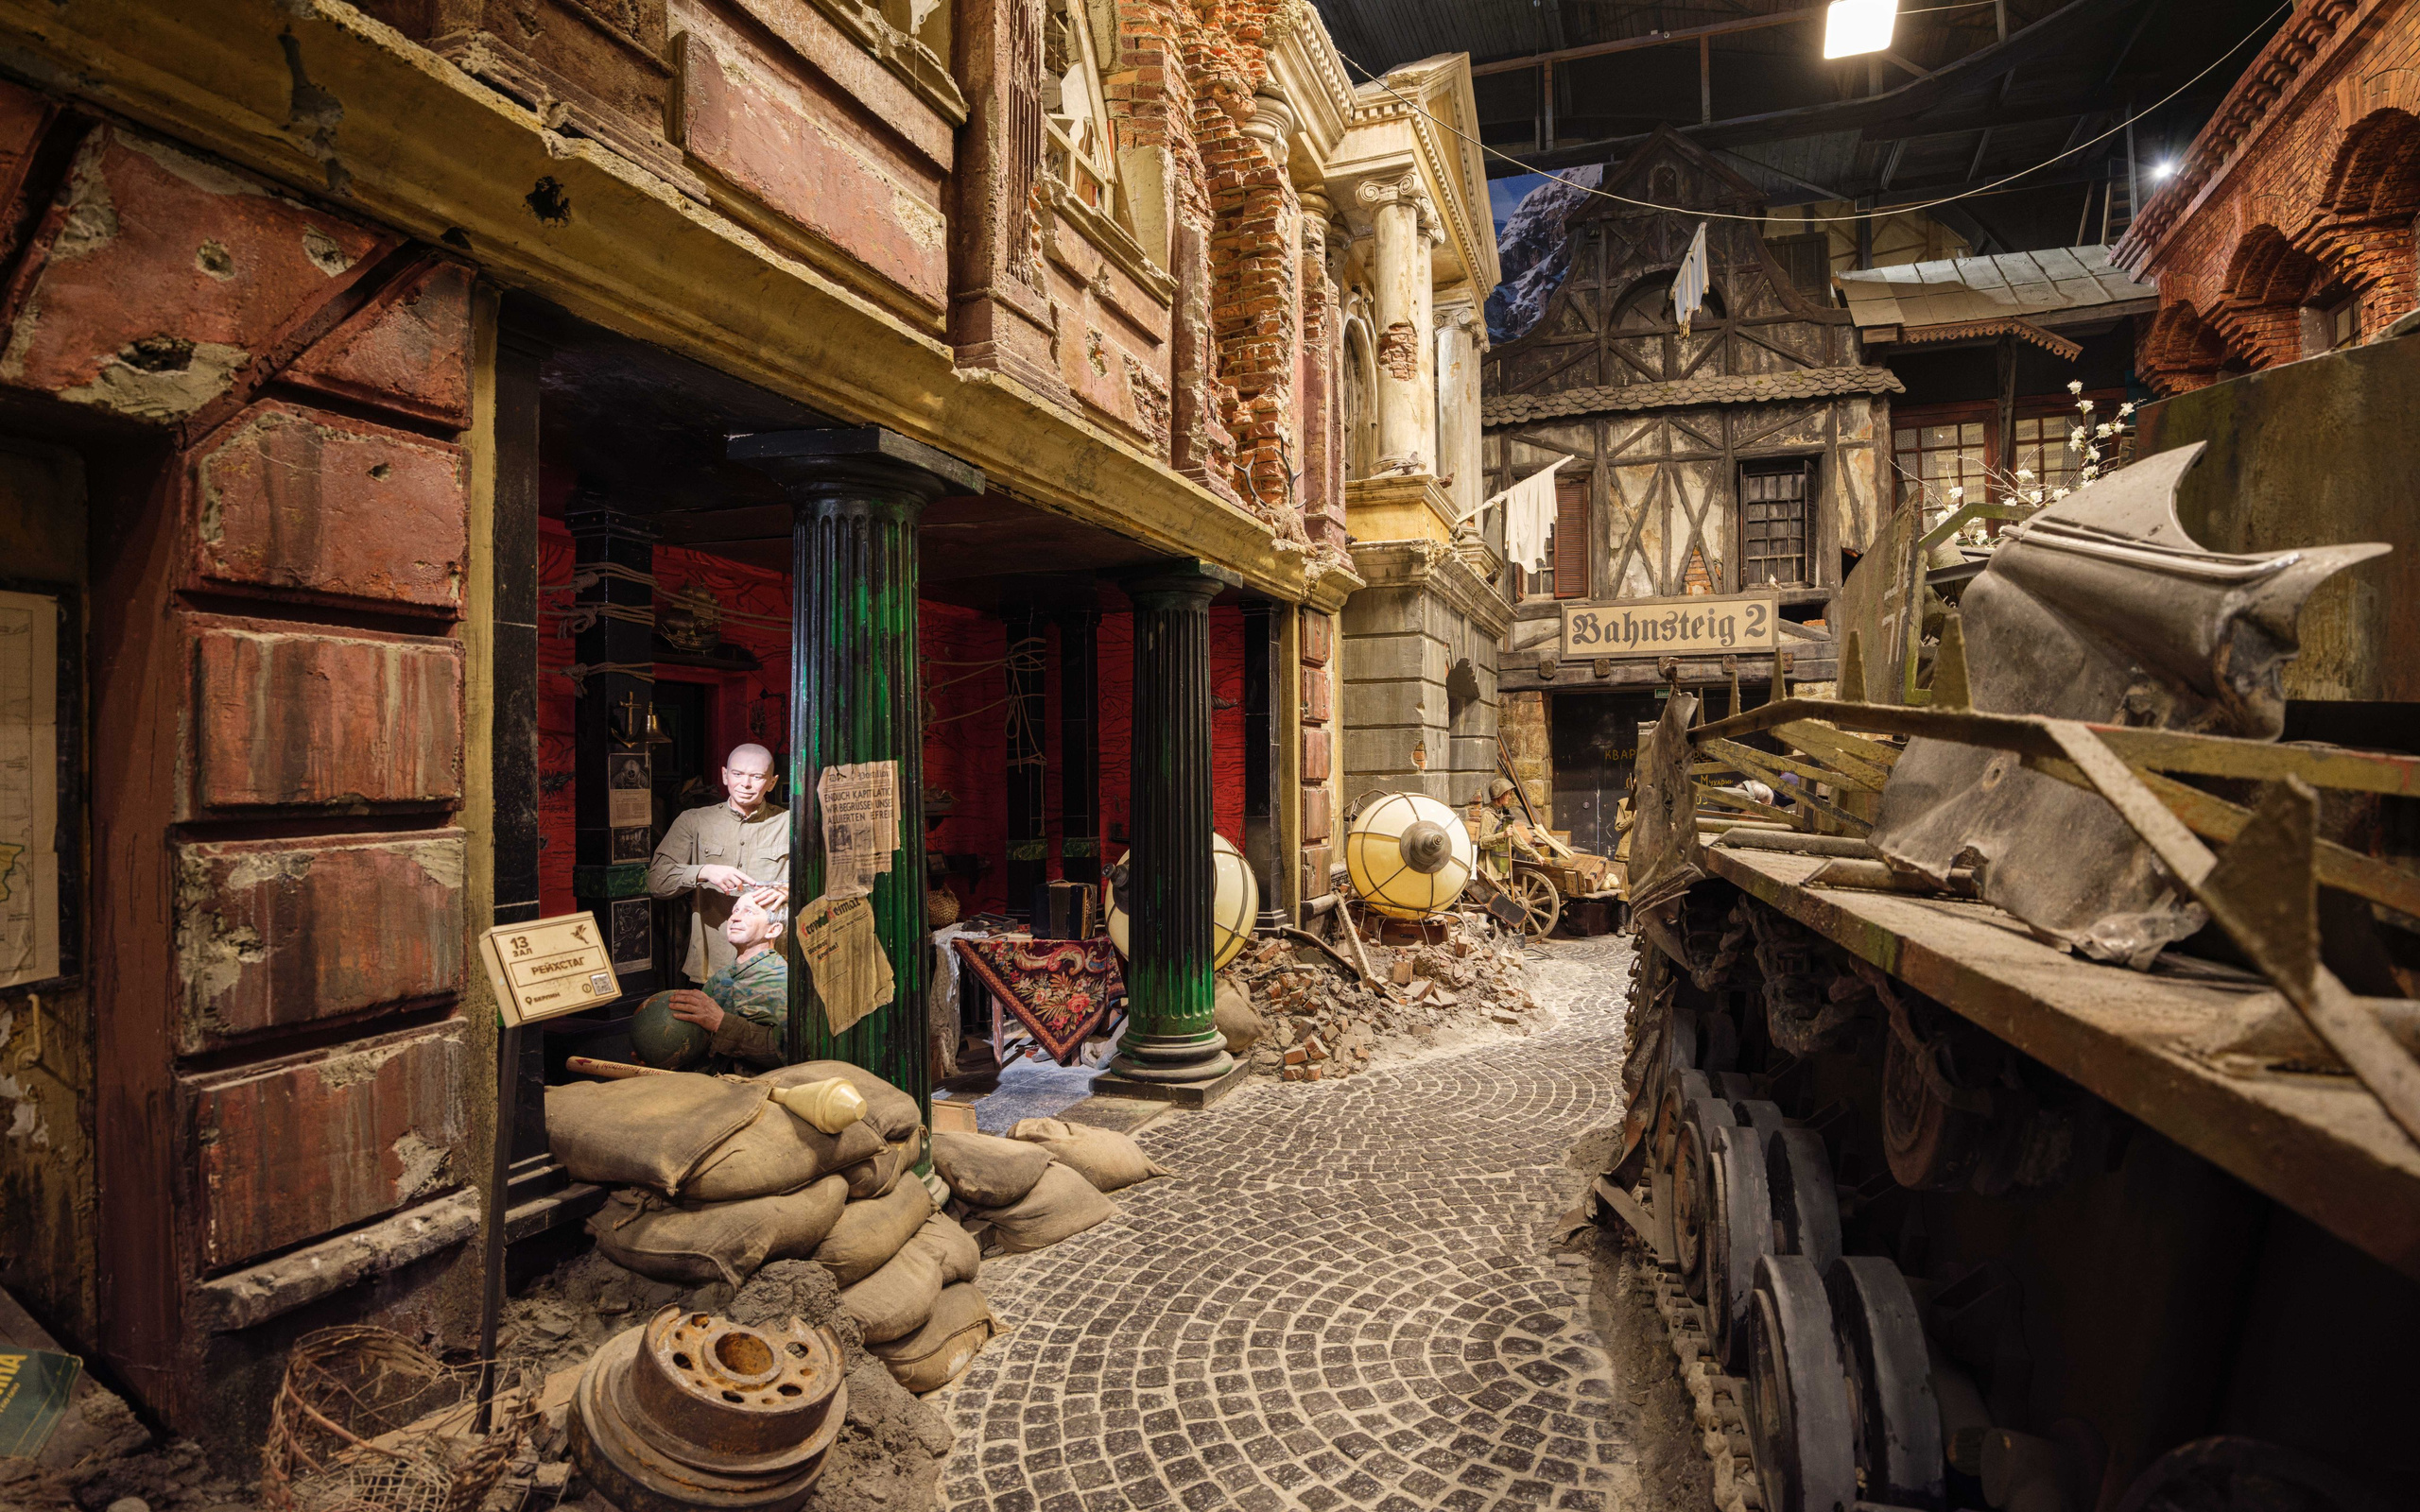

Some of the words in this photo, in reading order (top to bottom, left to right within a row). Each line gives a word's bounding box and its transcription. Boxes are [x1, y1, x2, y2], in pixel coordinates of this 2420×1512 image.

[1571, 608, 1736, 649] Bahnsteig
[1744, 604, 1767, 638] 2
[1604, 748, 1636, 761] КВАР
[839, 799, 873, 813] BEGRÜSSE
[510, 936, 529, 950] 13
[512, 948, 532, 958] ЗАЛ
[530, 956, 585, 975] РЕЙХСТАГ
[533, 991, 561, 1003] БЕРЛИН
